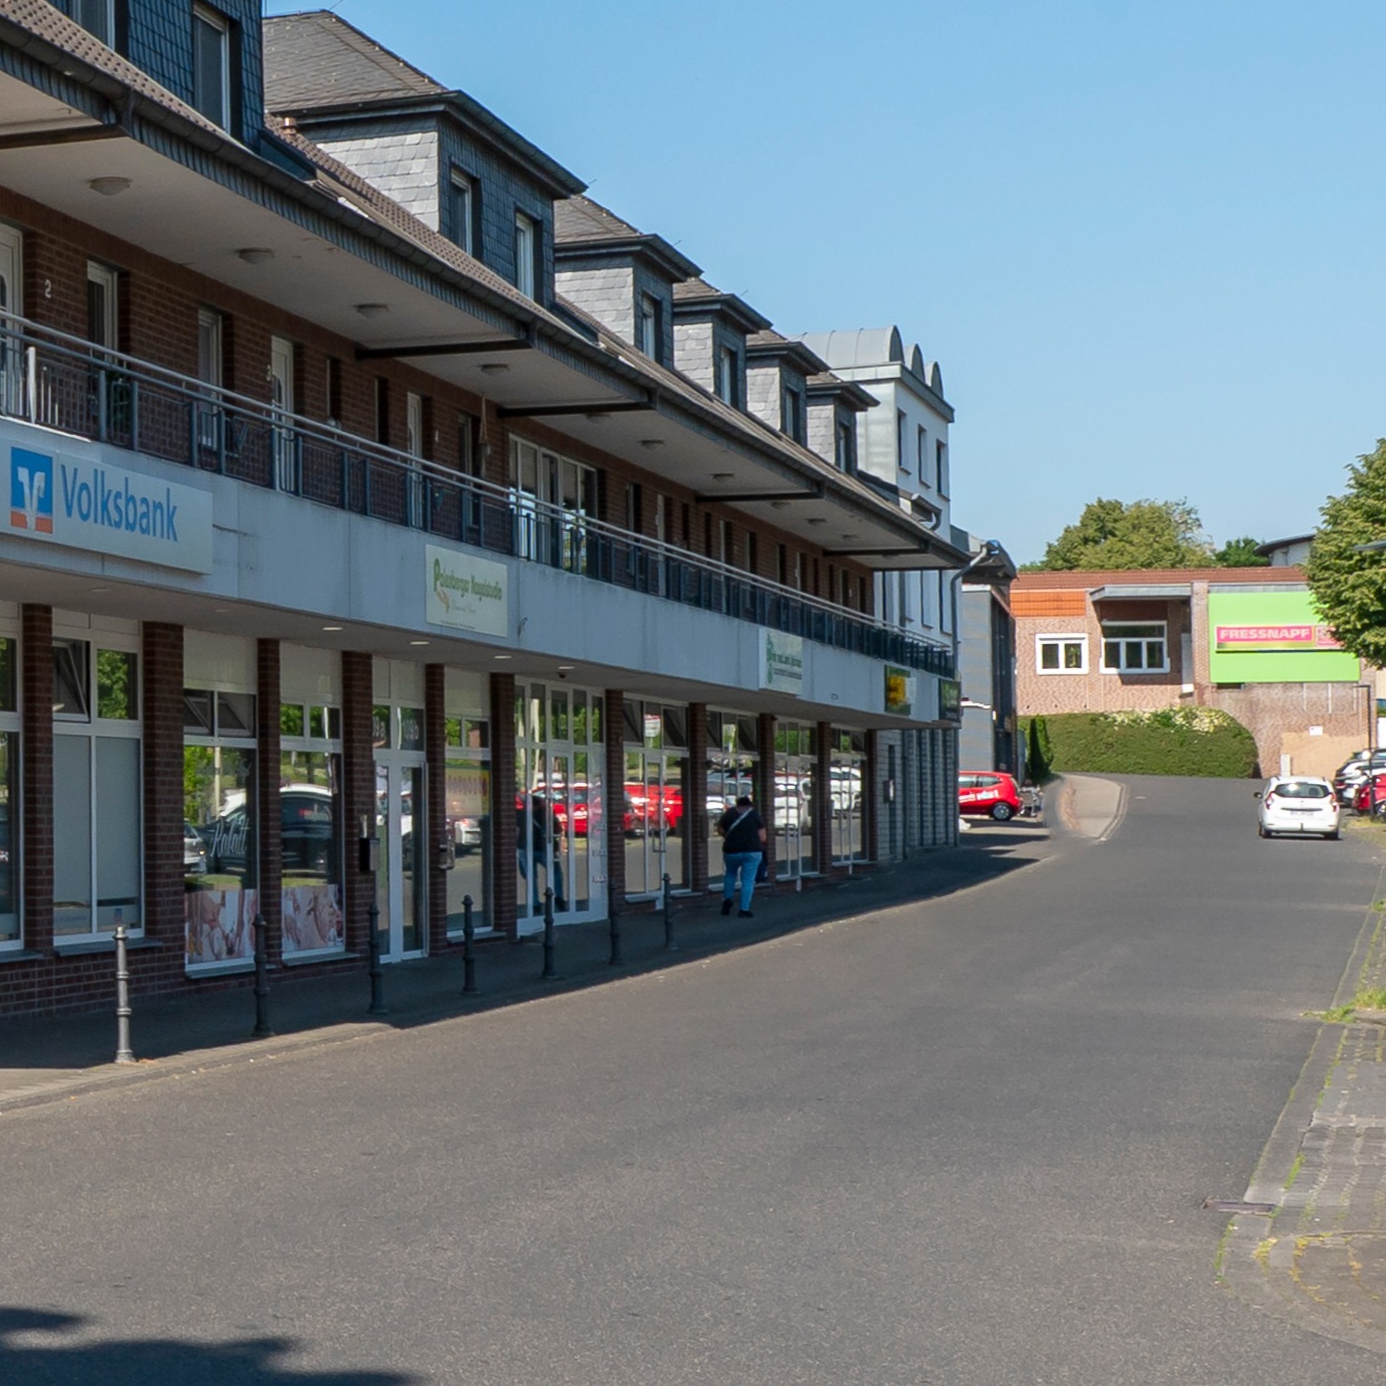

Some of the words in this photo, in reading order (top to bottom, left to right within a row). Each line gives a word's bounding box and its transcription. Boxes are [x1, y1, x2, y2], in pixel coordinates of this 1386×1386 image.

[44, 279, 52, 299] 2
[61, 464, 178, 542] Volksbank
[1219, 628, 1310, 640] FRESSNAPF
